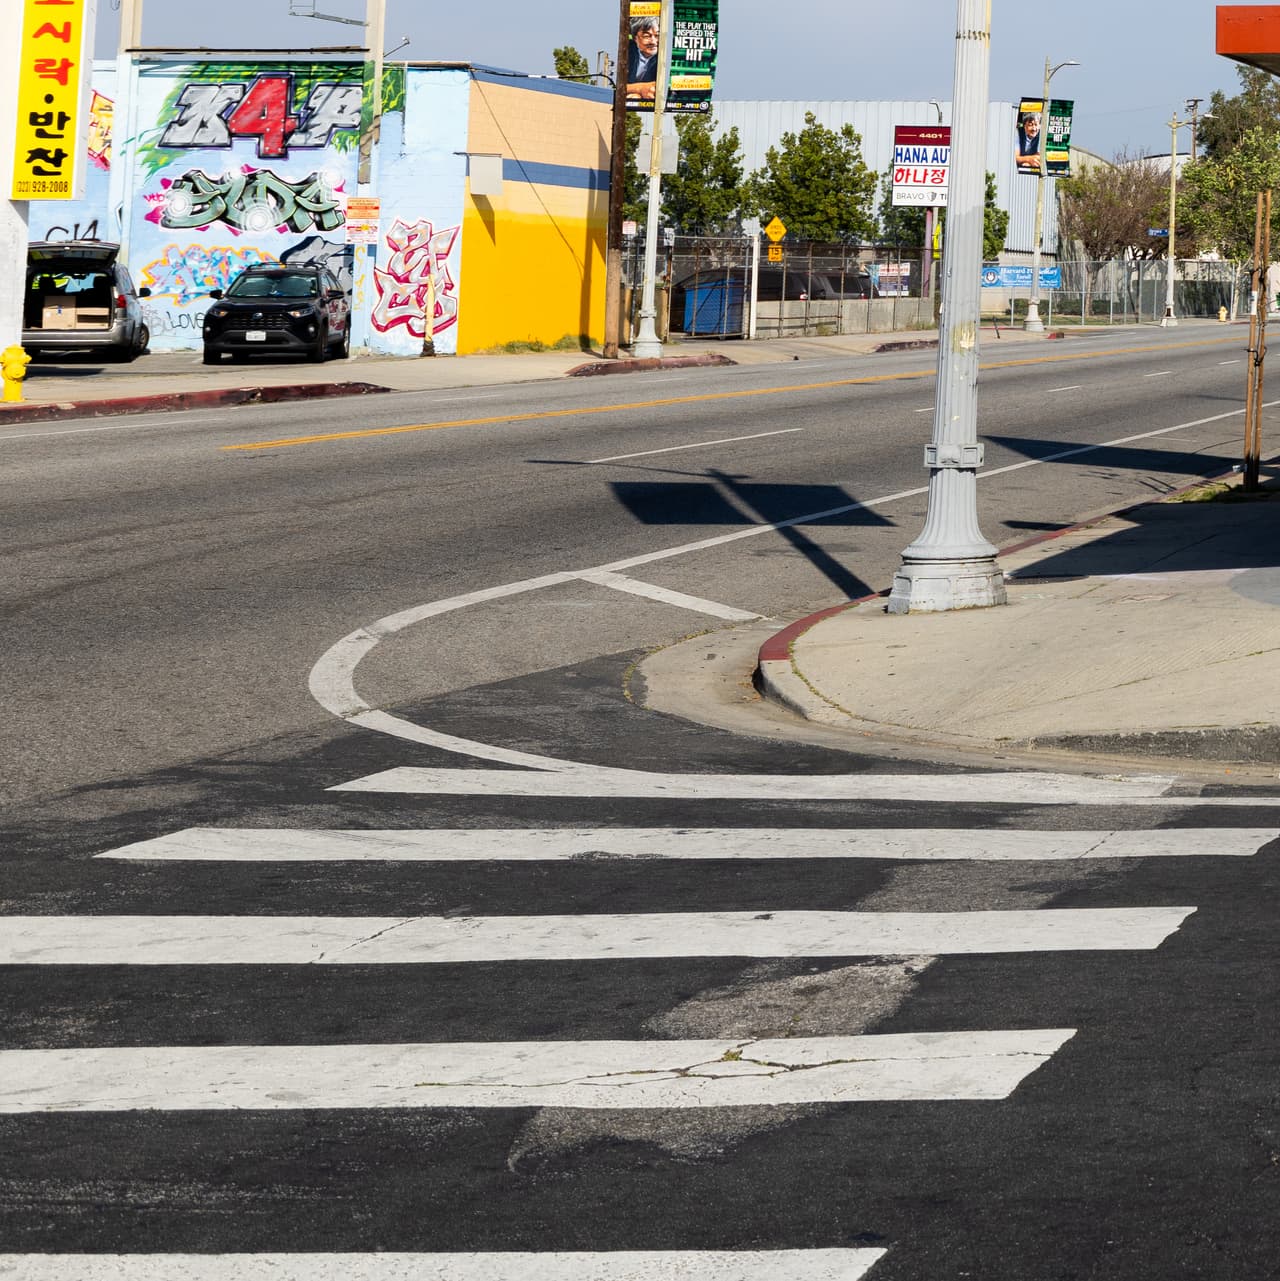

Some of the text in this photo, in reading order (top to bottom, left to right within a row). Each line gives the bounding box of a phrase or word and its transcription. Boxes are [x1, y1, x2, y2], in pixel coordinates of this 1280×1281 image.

[675, 21, 716, 31] THE PLAY THAT
[674, 36, 716, 50] NETFLIX
[686, 49, 704, 61] HIT
[895, 147, 929, 164] HANA
[32, 180, 69, 193] 928-2008
[896, 192, 925, 200] BRAVO
